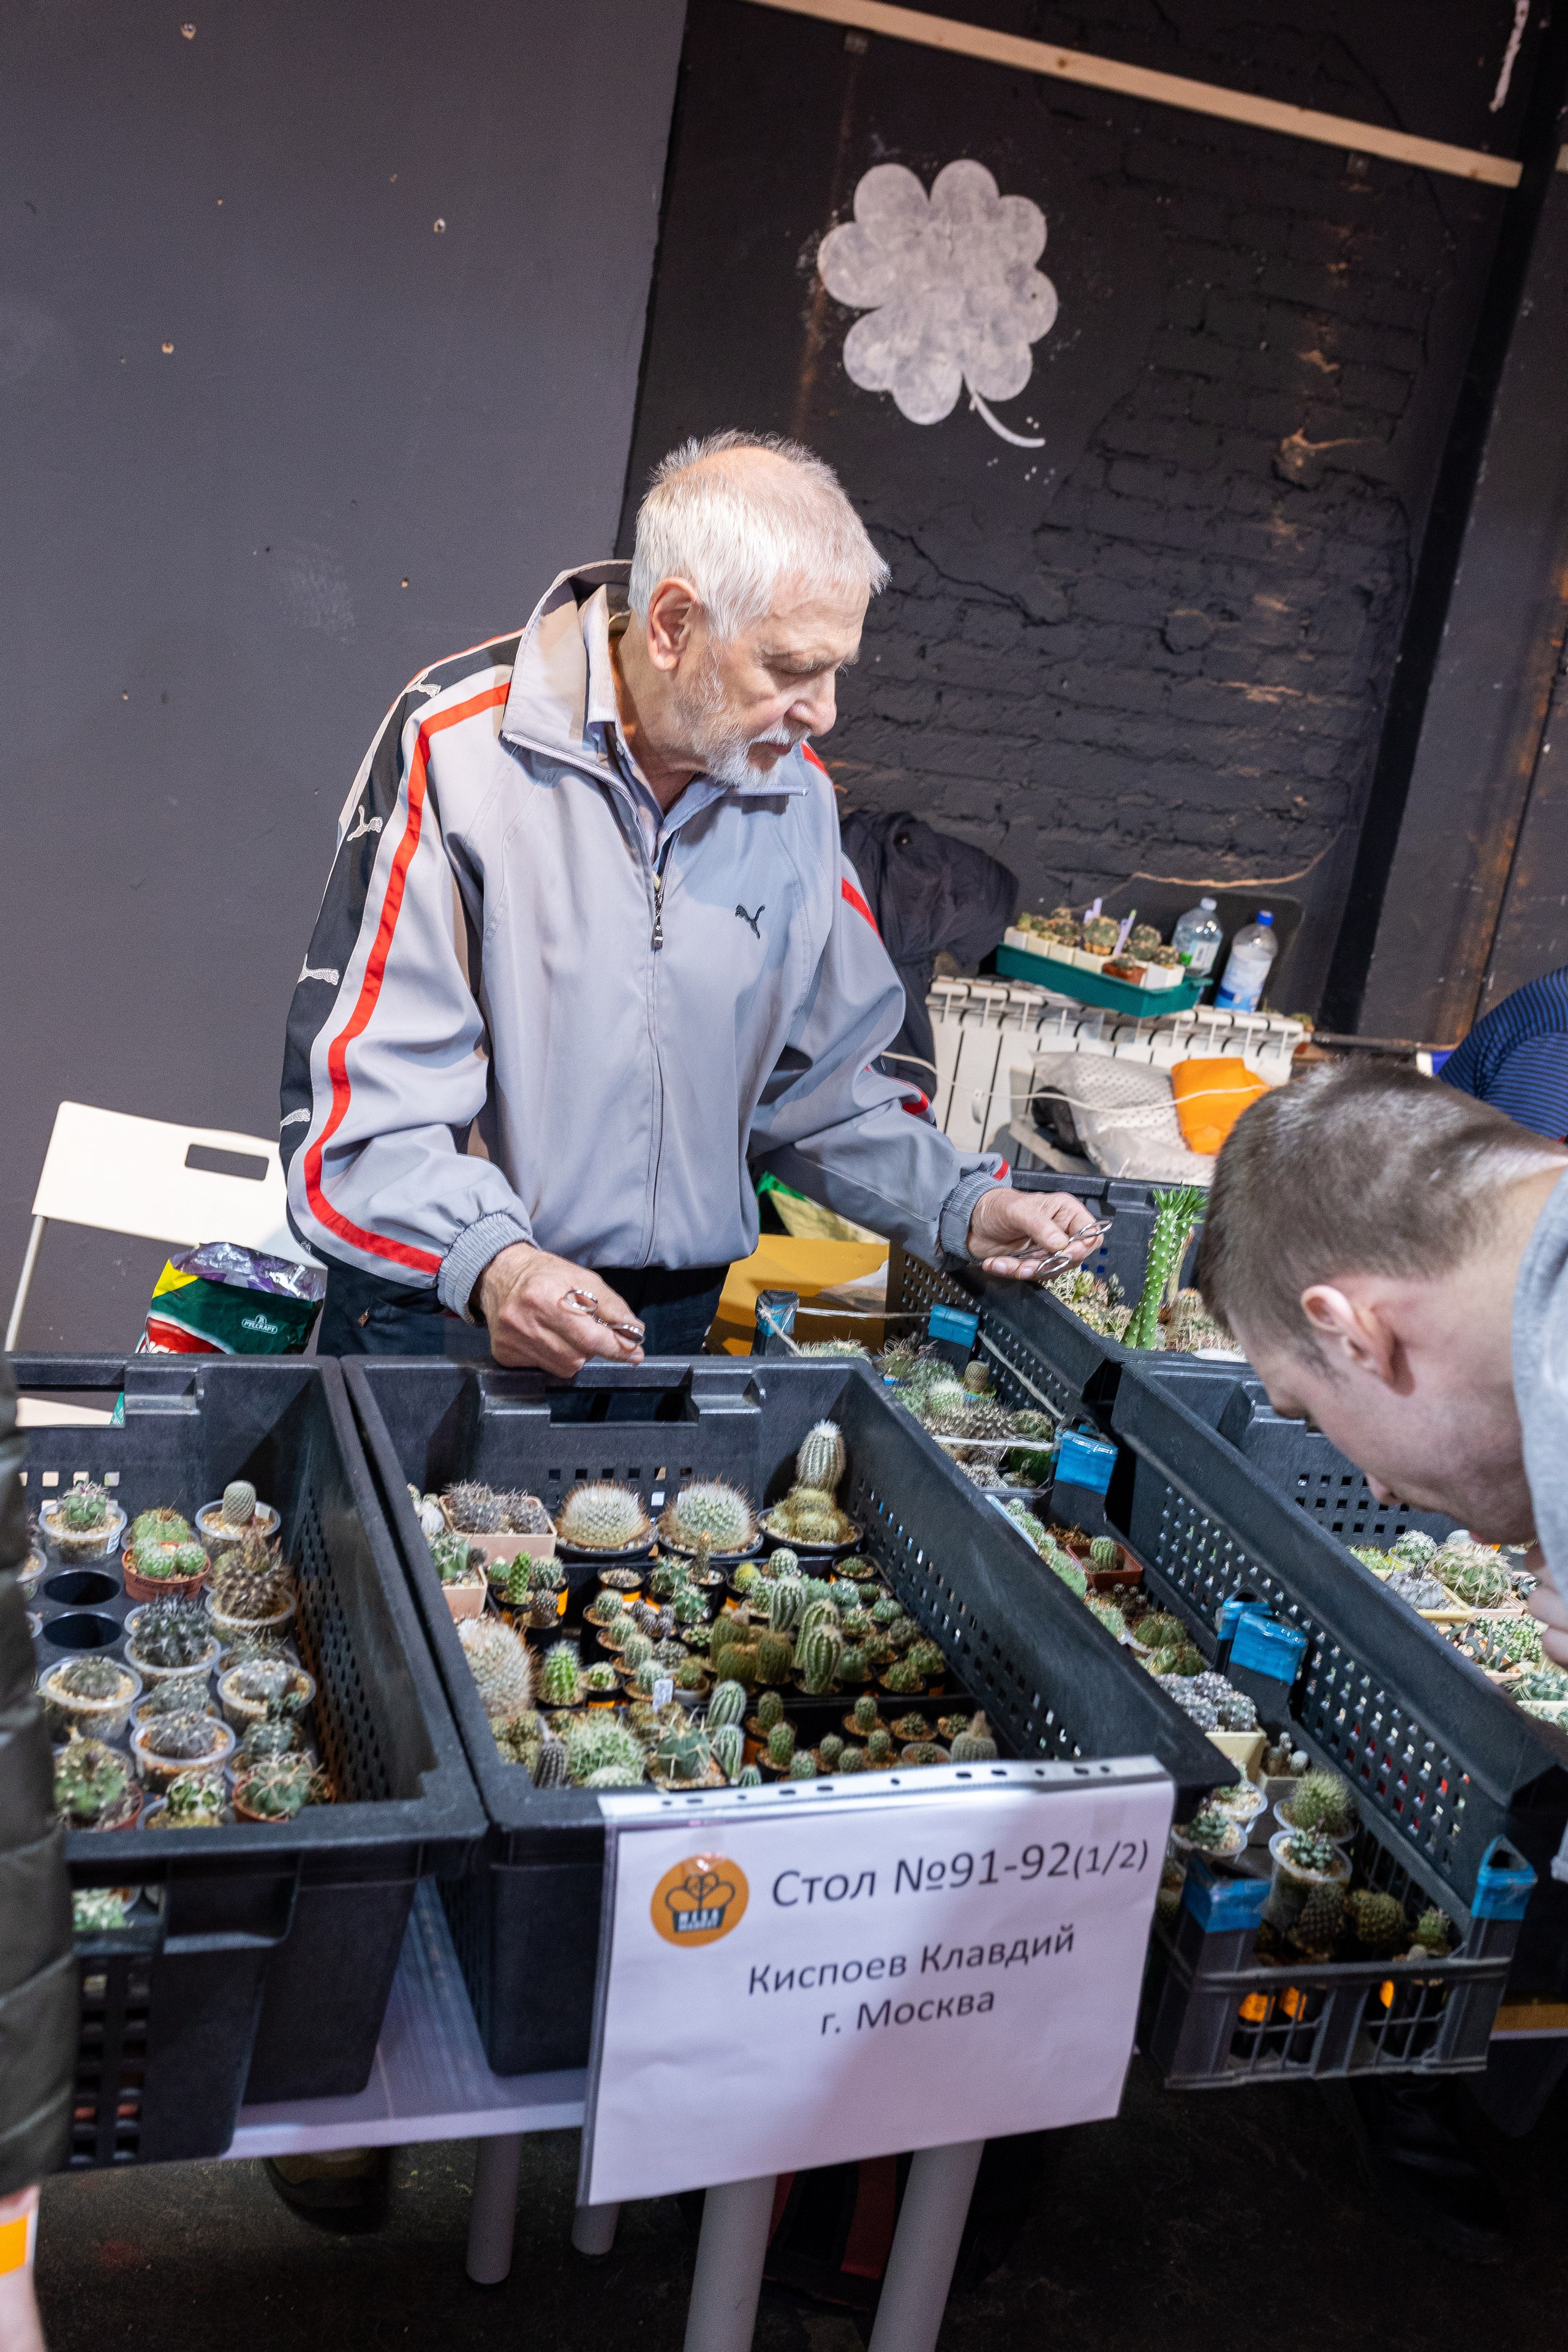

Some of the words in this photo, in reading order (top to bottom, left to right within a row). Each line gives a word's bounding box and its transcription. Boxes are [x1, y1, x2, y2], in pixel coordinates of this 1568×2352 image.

[772, 1869, 876, 1907] Стол
[894, 1839, 1148, 1894] №91-92(1/2)
[748, 1953, 907, 1996] Киспоев
[920, 1923, 1075, 1973] Клавдий
[820, 2011, 842, 2035] г.
[857, 1989, 995, 2030] Москва
